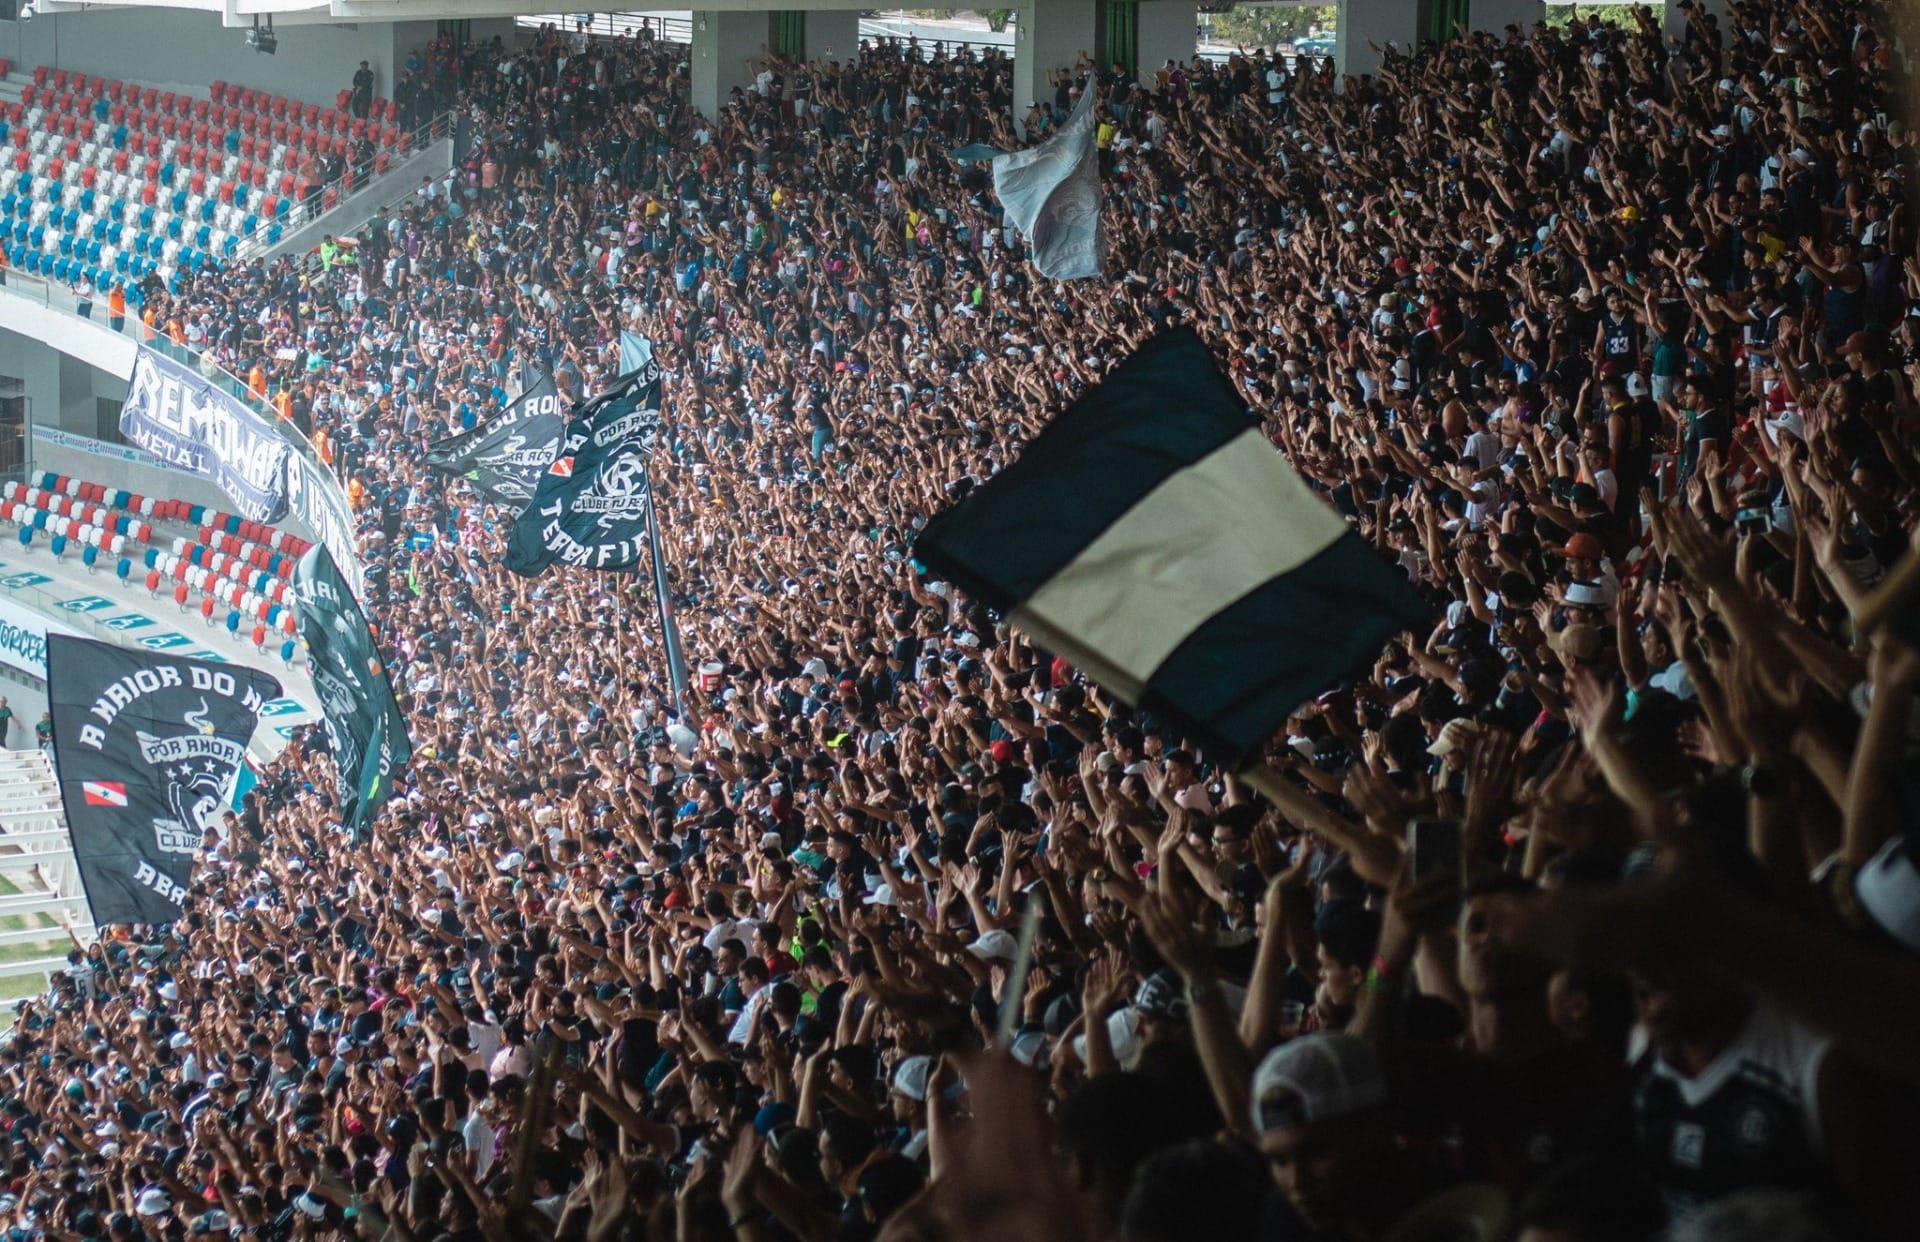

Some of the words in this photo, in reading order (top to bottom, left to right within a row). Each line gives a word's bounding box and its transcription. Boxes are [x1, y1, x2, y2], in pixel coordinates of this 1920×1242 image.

[1610, 336, 1630, 354] 33
[599, 421, 626, 443] POR
[133, 422, 211, 475] METAL
[216, 468, 271, 523] AZULINO
[189, 666, 236, 697] DO
[90, 665, 183, 725] MAIOR
[79, 724, 106, 750] A
[147, 740, 181, 760] POR
[186, 738, 234, 760] AMOR
